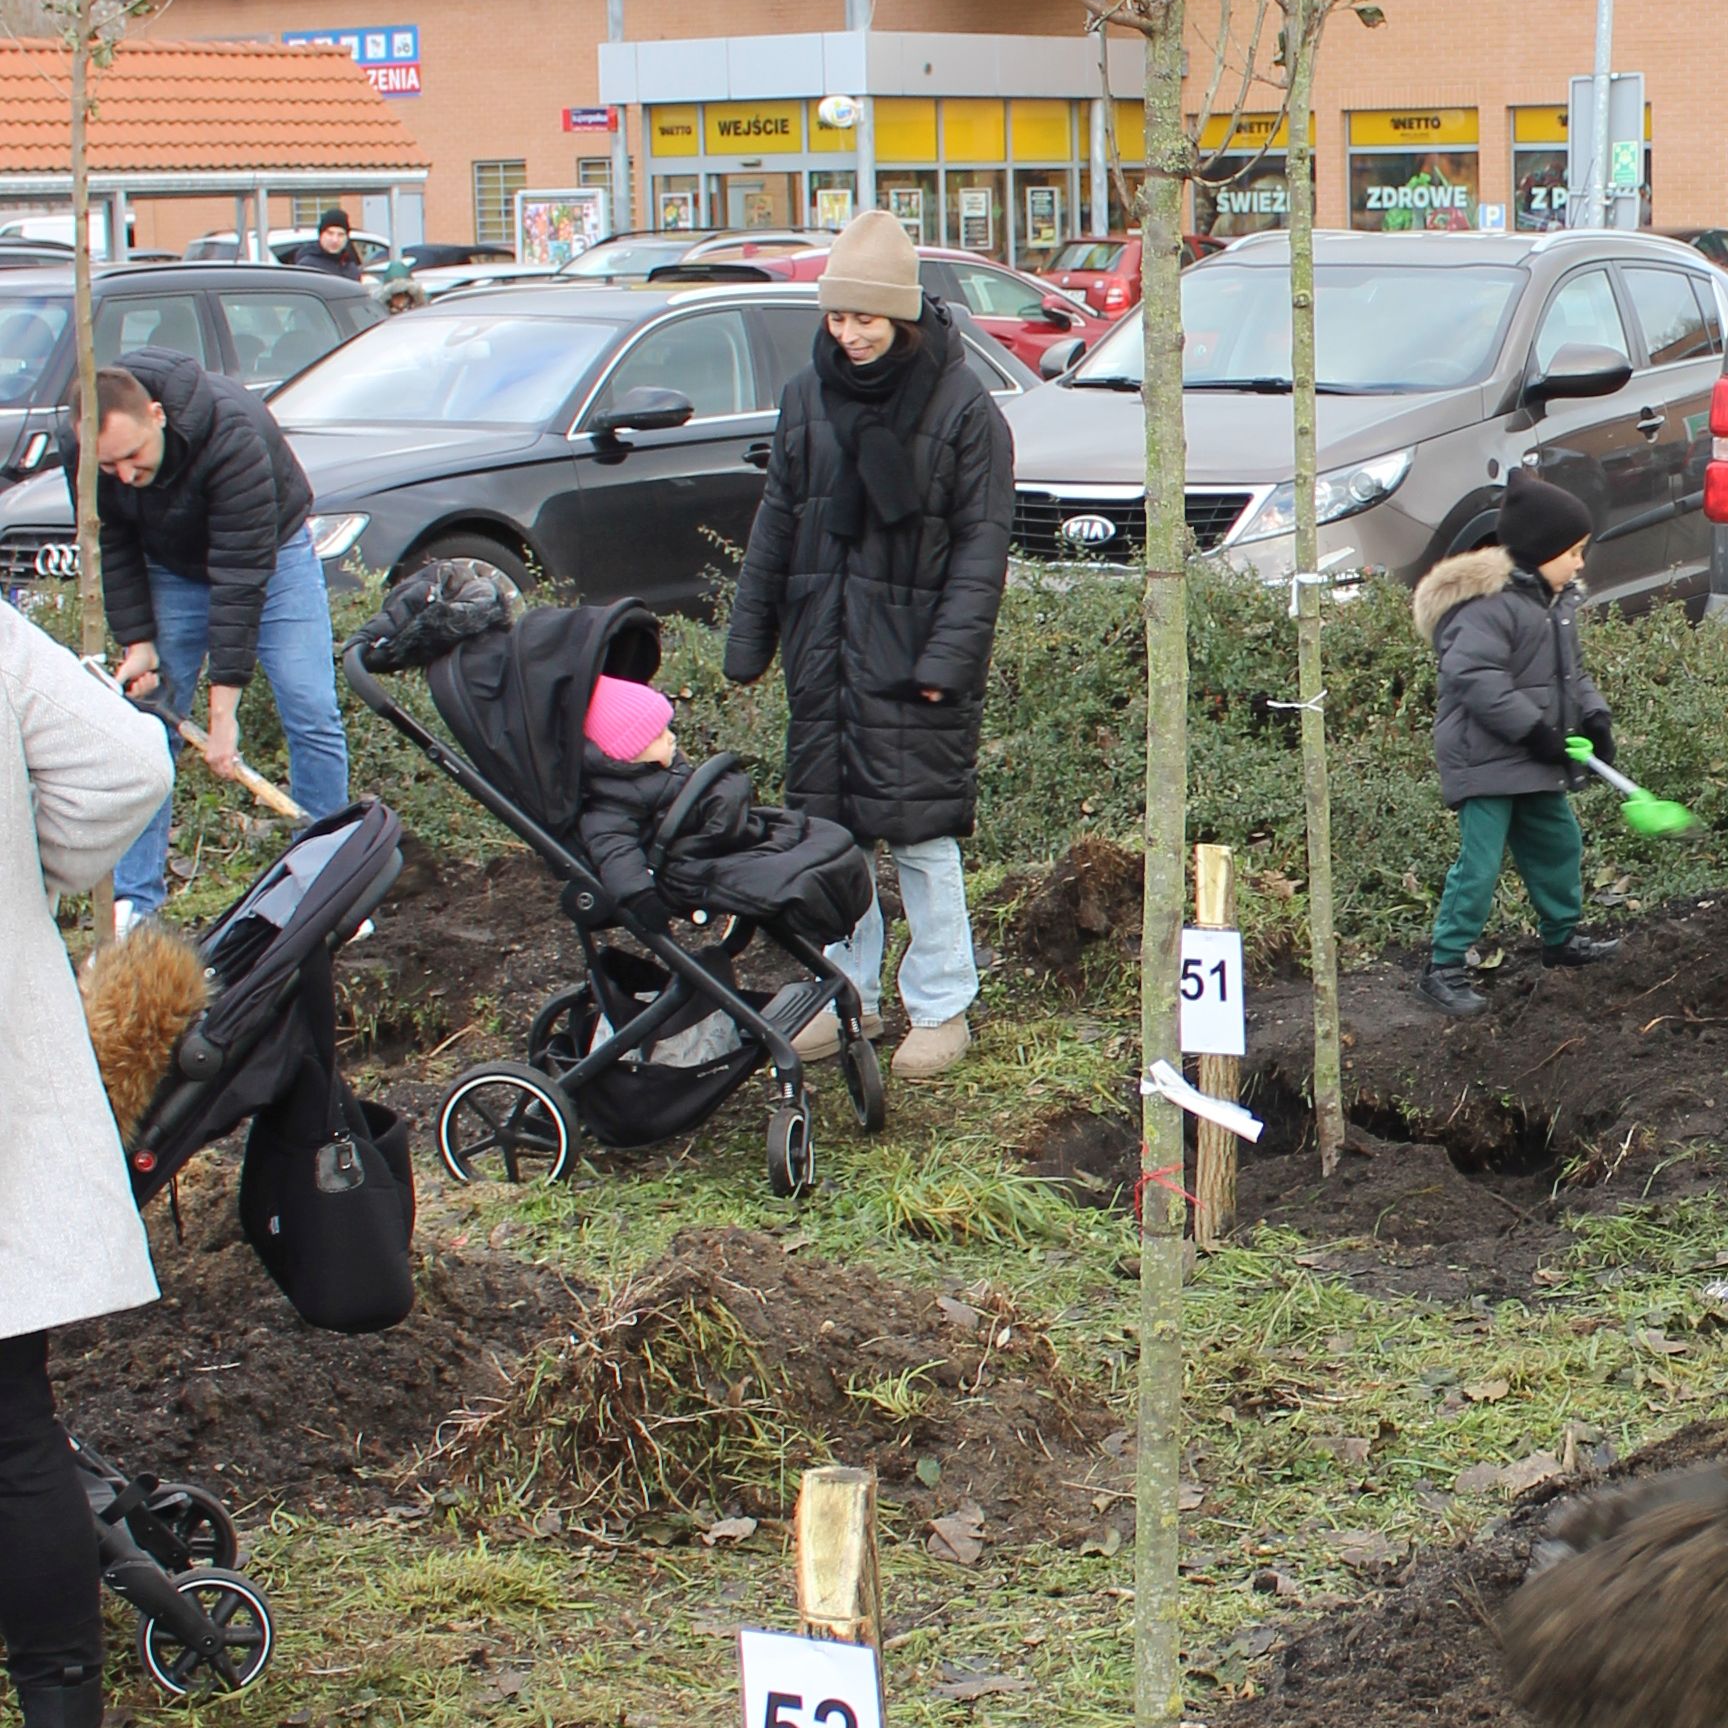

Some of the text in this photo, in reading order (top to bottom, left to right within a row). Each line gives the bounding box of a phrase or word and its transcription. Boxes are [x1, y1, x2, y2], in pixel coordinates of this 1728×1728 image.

[718, 117, 790, 137] WEJŚCIE
[1390, 117, 1441, 131] NETTO
[1366, 186, 1467, 210] ZDROWE
[1069, 521, 1104, 540] KIA
[1181, 959, 1228, 1002] 51
